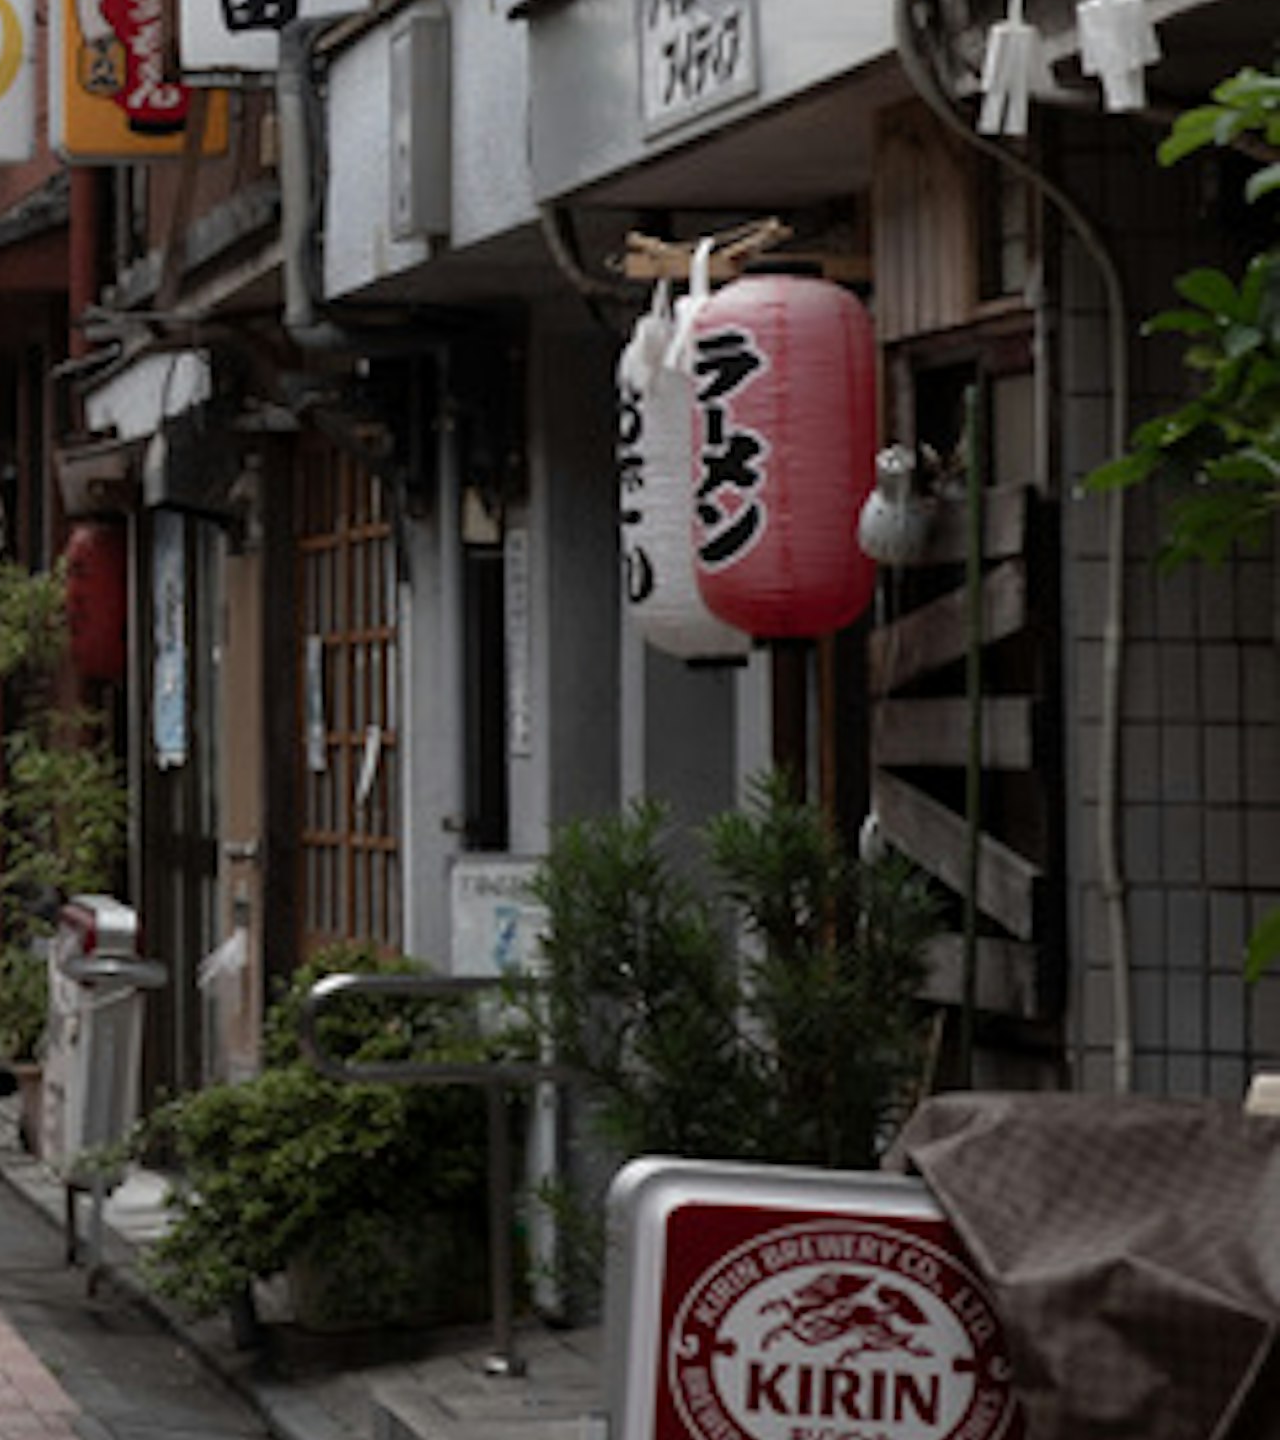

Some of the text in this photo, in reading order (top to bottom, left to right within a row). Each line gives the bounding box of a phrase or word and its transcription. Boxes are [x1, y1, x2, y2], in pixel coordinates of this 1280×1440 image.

[694, 331, 765, 566] ラーメン
[694, 1257, 764, 1328] KIRIN
[759, 1232, 901, 1273] BREWERY
[745, 1362, 941, 1427] KIRIN
